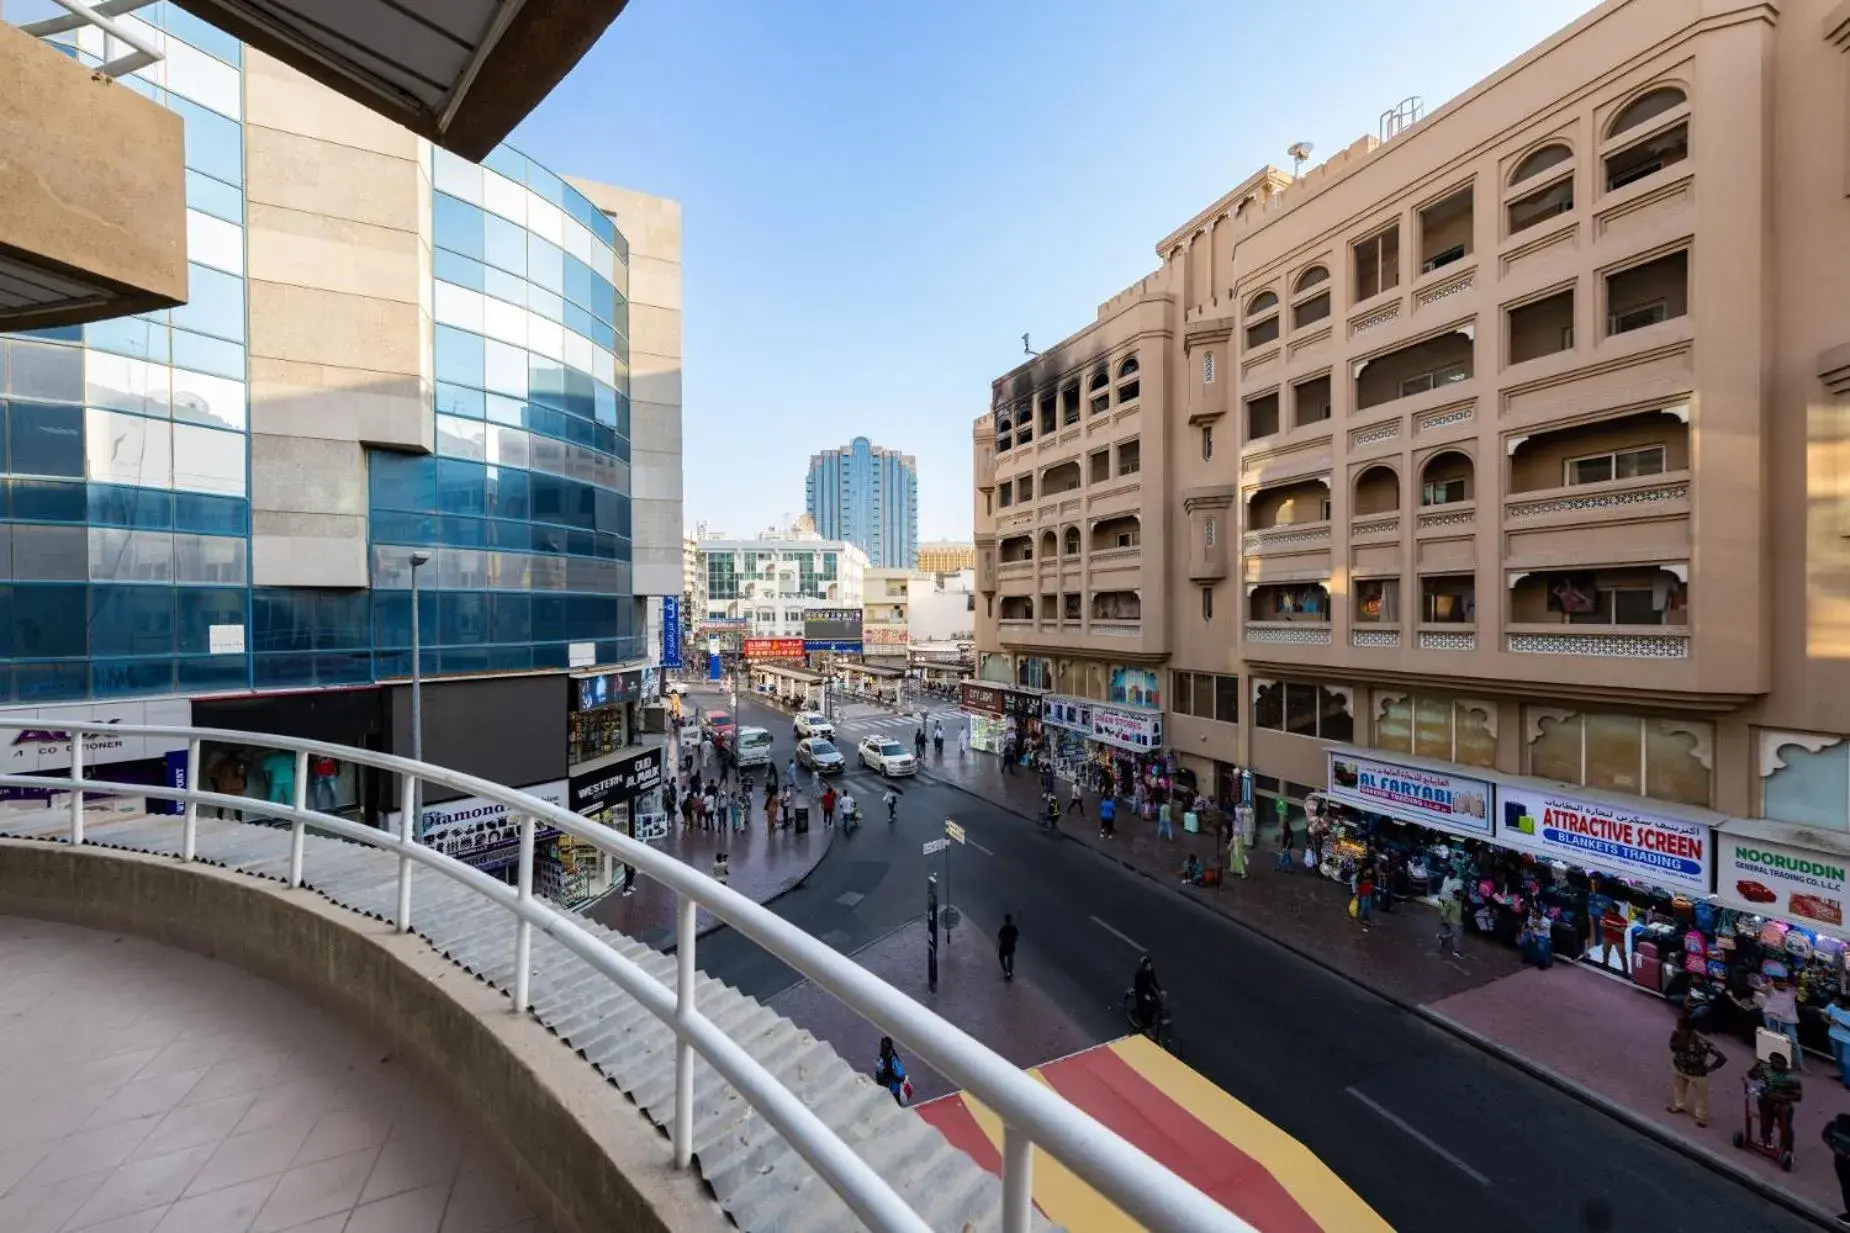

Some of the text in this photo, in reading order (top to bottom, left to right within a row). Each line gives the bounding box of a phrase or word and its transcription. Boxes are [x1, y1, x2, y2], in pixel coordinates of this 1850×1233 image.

[577, 774, 623, 799] WESTERN
[1359, 772, 1454, 805] AL FARYABI
[1542, 807, 1634, 847] ATTRACTIVE
[1637, 826, 1703, 861] SCREEN
[1558, 830, 1619, 855] BLANKETS
[1622, 846, 1682, 870] TRADING
[1735, 846, 1846, 882] NOORUDDIN
[1735, 861, 1769, 875] GENERAL
[1770, 868, 1805, 883] TRADING
